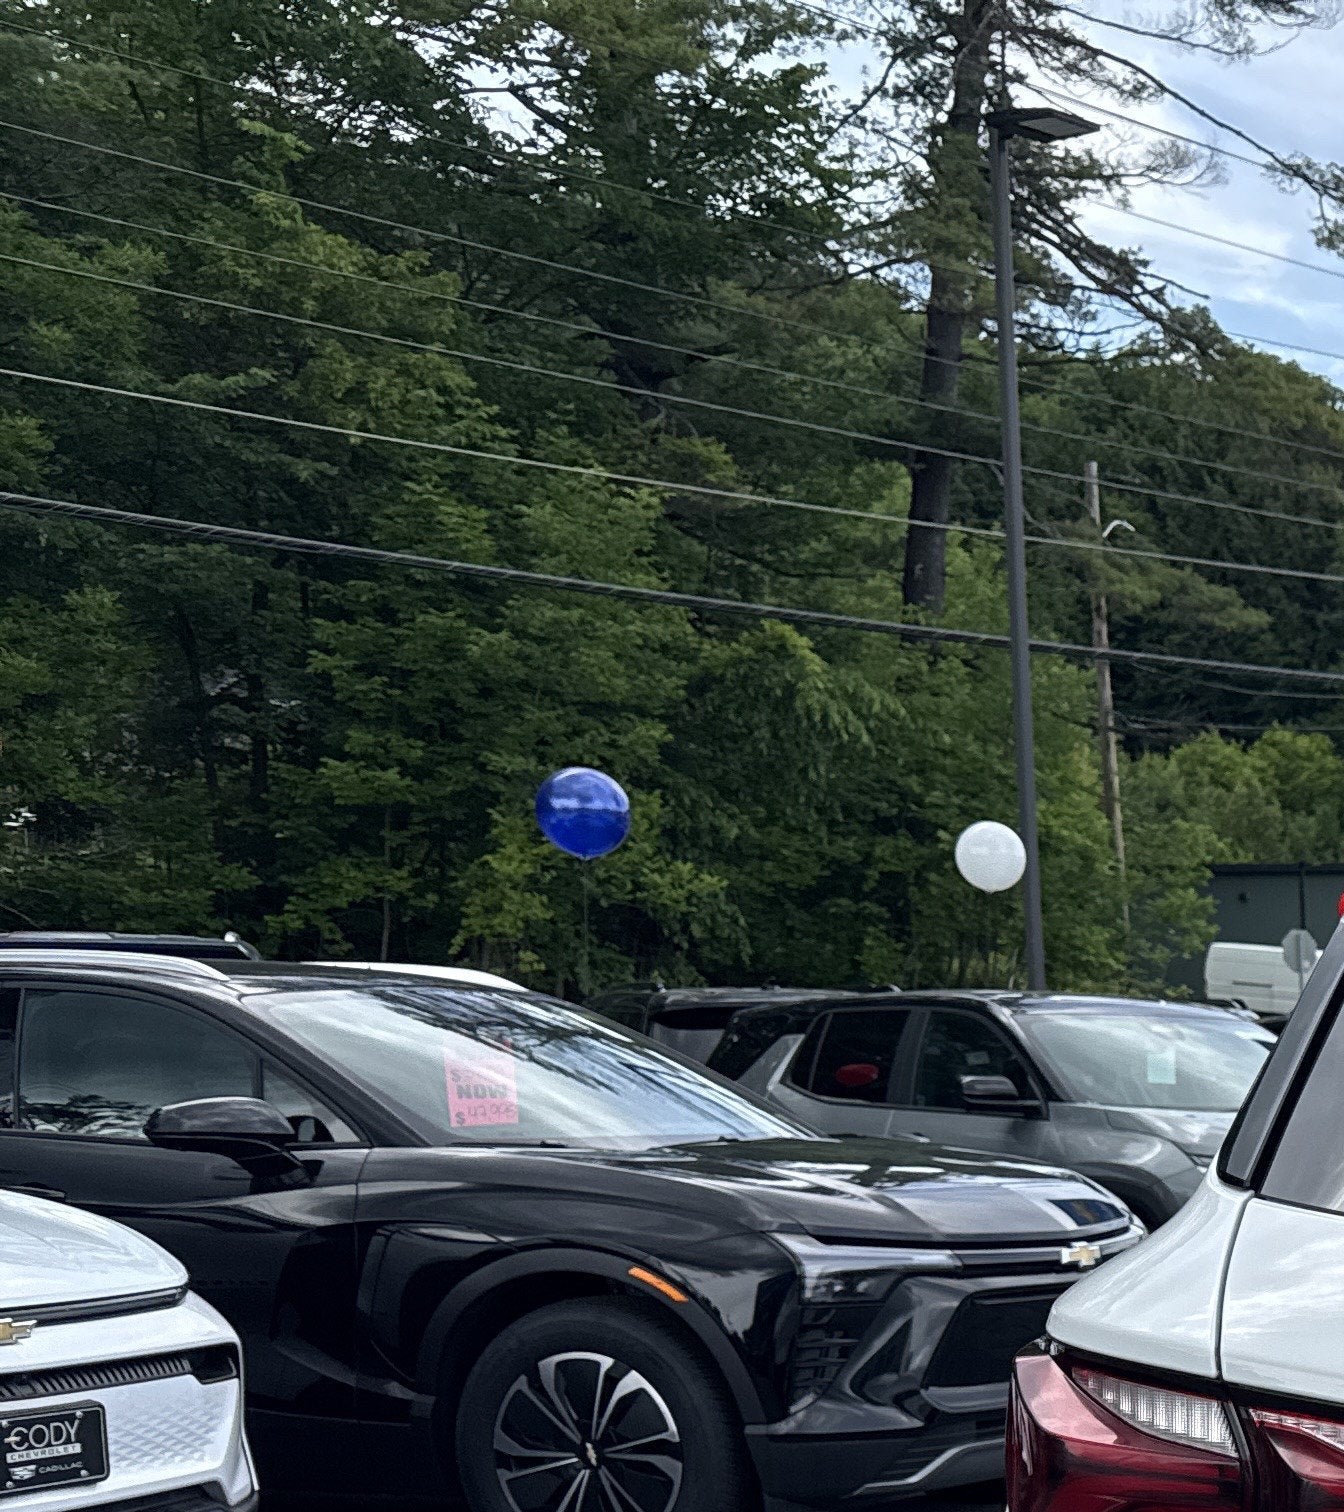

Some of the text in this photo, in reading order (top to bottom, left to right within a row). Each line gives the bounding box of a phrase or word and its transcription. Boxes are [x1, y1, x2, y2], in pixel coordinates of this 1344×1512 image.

[457, 1083, 507, 1099] NOW
[9, 1419, 79, 1450] CODY
[9, 1445, 77, 1461] CHEVROLET
